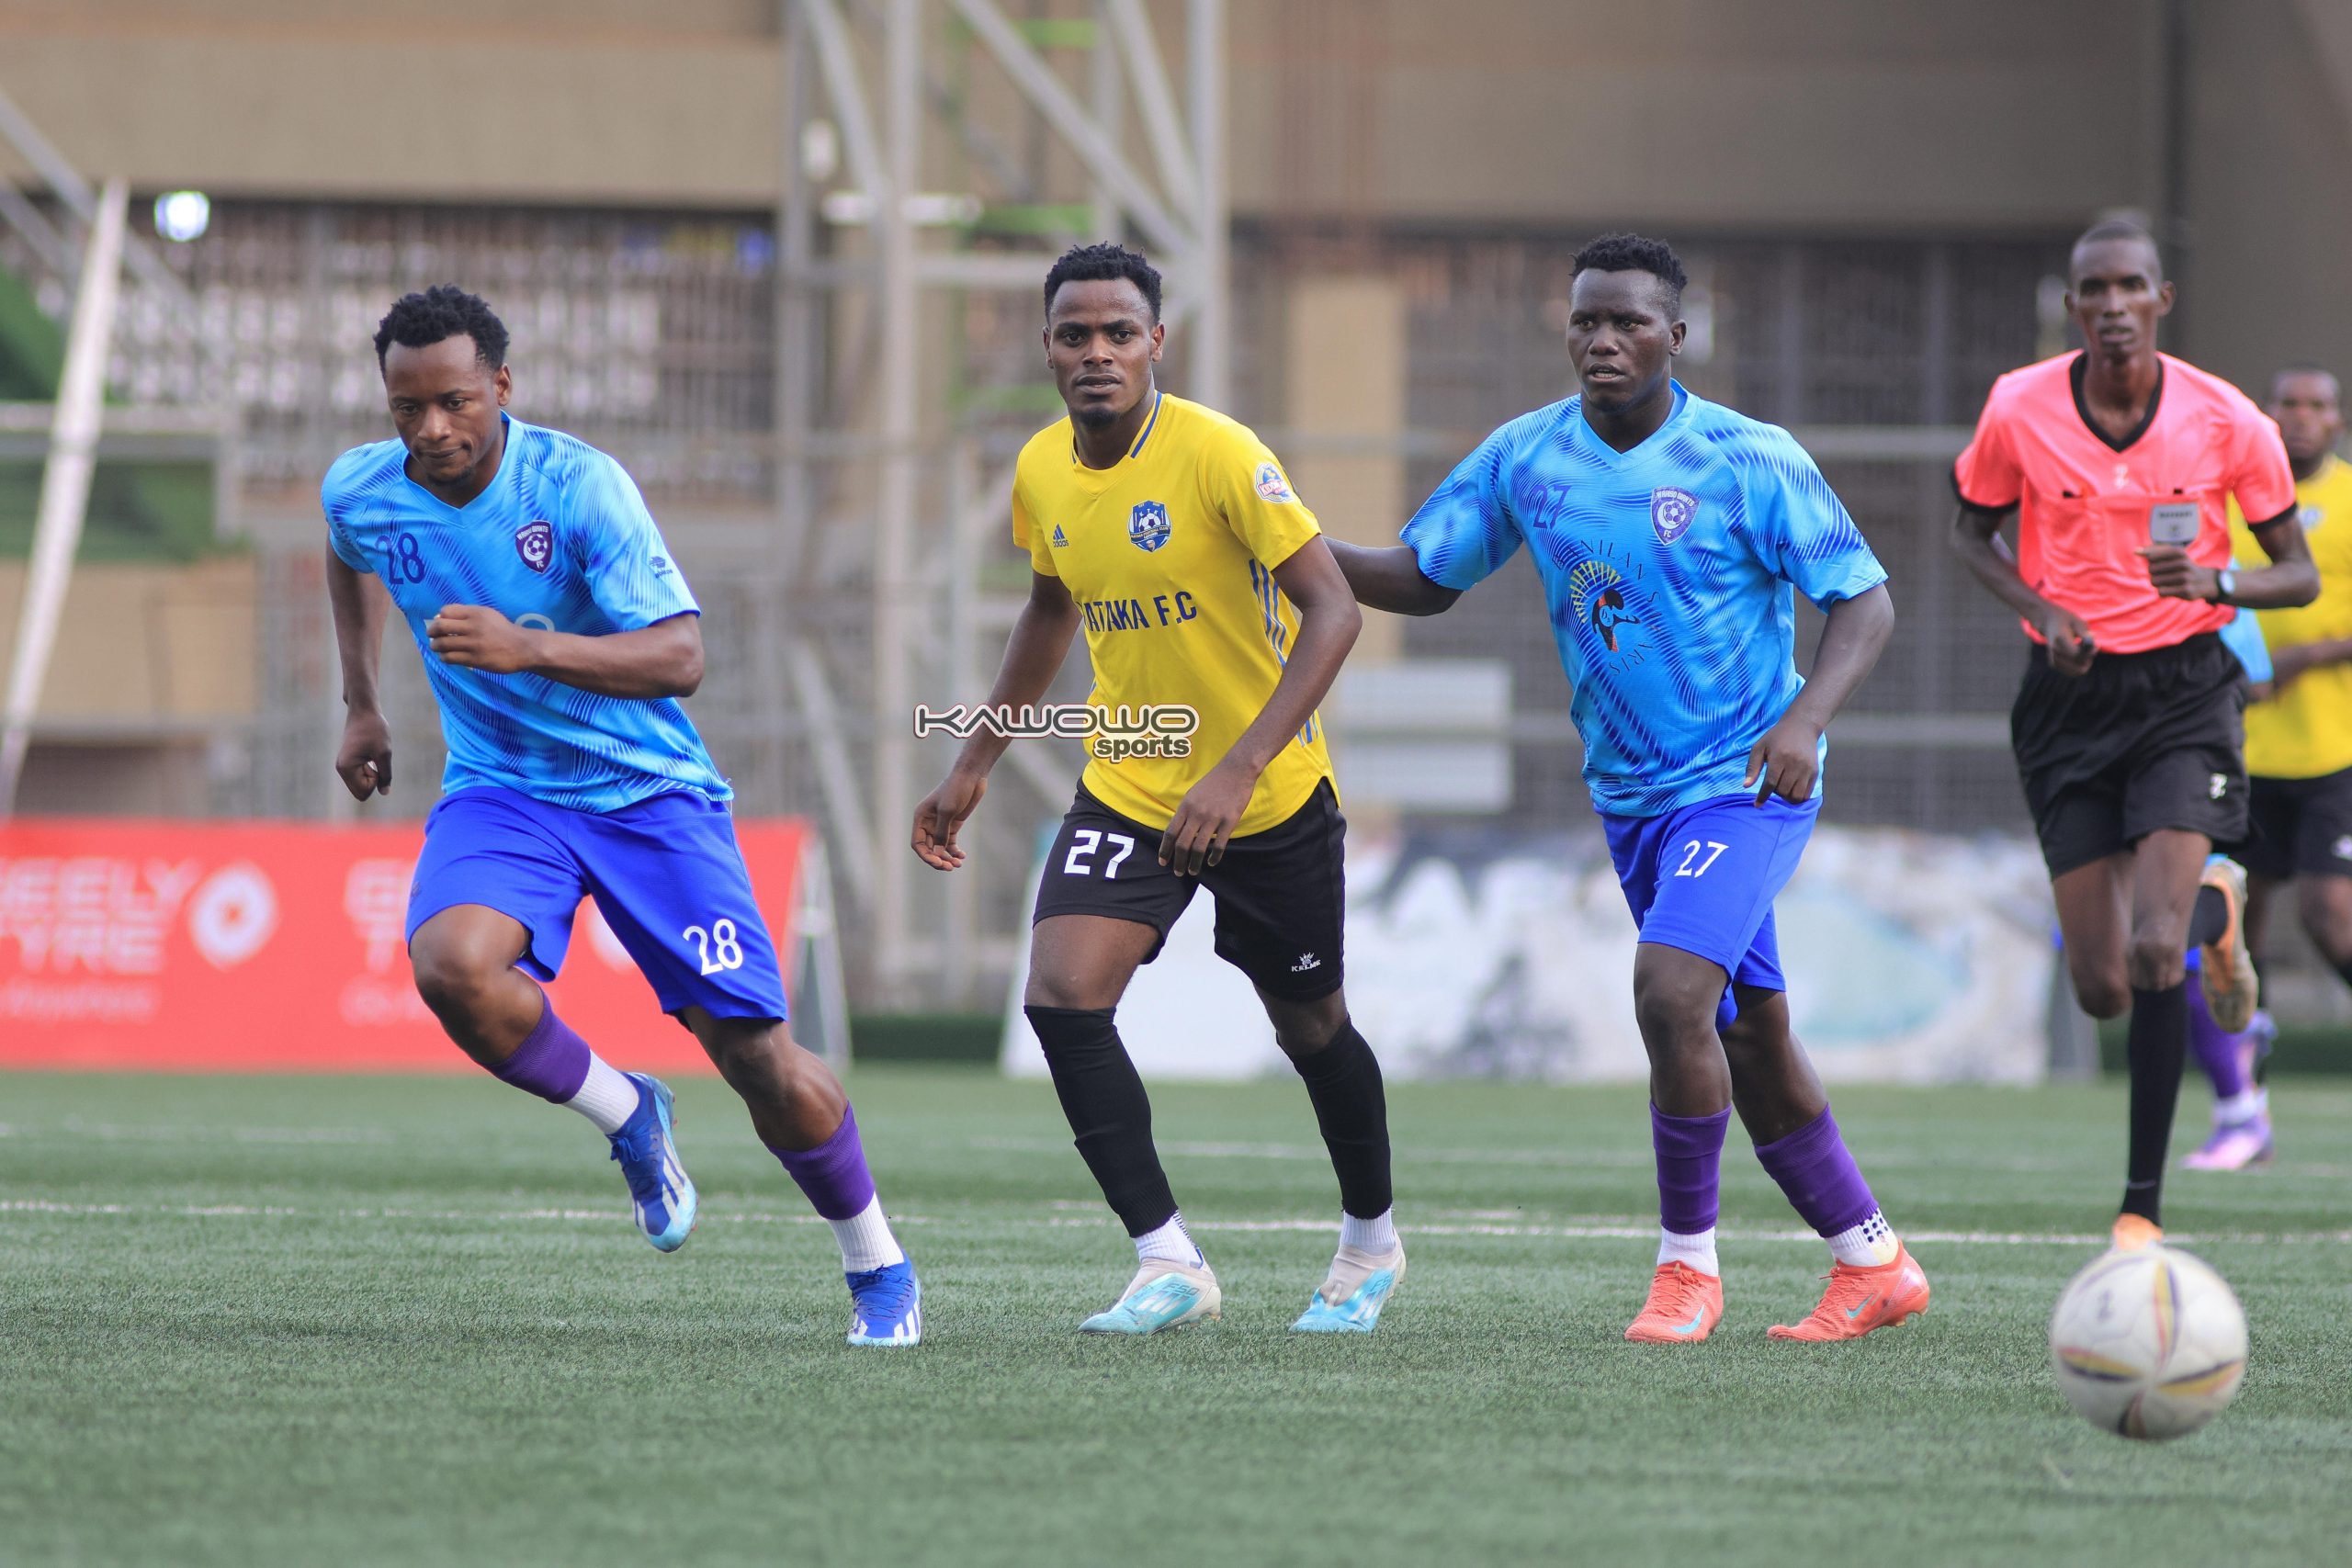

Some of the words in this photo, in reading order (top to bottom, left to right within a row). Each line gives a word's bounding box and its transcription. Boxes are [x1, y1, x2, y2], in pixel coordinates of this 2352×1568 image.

[1531, 484, 1572, 530] 27
[1664, 529, 1672, 538] FC
[375, 533, 425, 584] 28
[1079, 599, 1150, 632] ATAKA
[1153, 591, 1197, 626] F.C
[1064, 829, 1135, 879] 27
[1674, 840, 1730, 878] 27
[0, 857, 199, 920] EELY
[0, 919, 164, 975] YRE
[683, 919, 743, 976] 28
[1291, 959, 1321, 972] KELME
